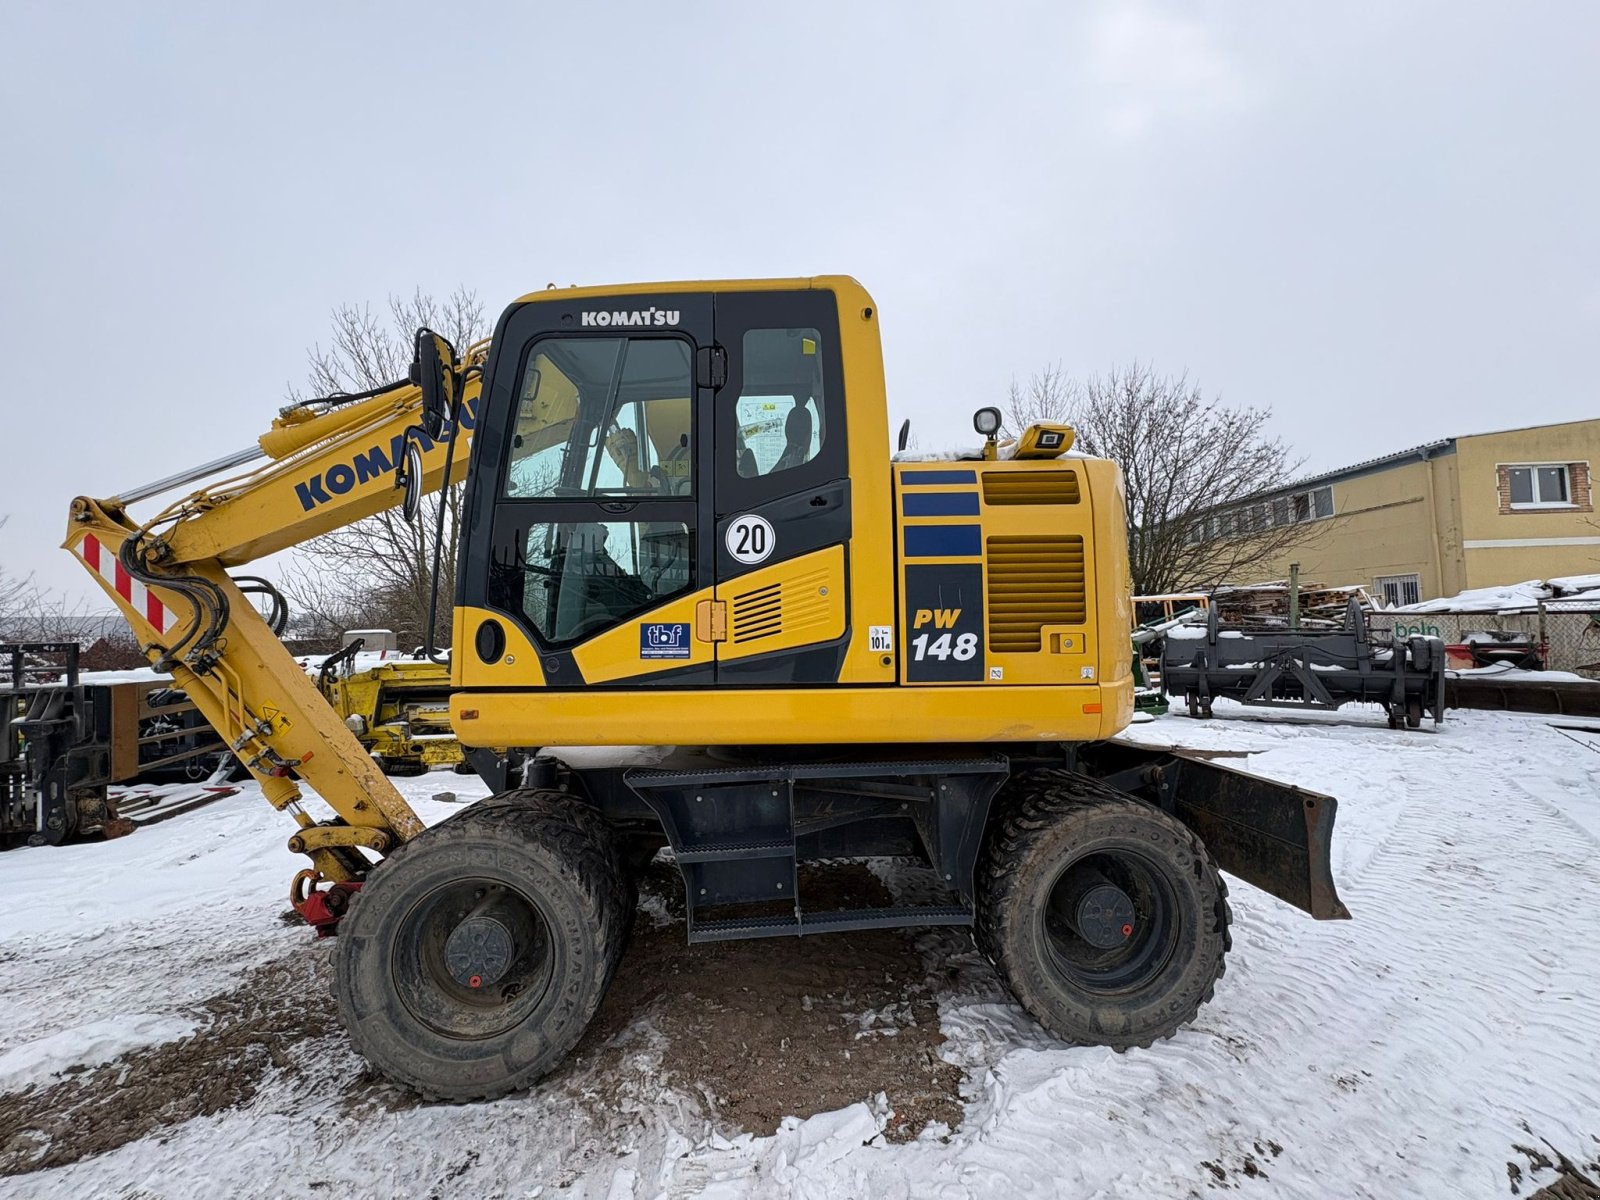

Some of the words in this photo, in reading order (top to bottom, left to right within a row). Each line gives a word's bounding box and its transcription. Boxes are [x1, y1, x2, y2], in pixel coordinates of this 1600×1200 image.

[581, 306, 680, 327] KOMATSU
[736, 524, 766, 554] 20
[913, 608, 961, 629] PW
[871, 636, 885, 649] 101
[912, 632, 978, 661] 148
